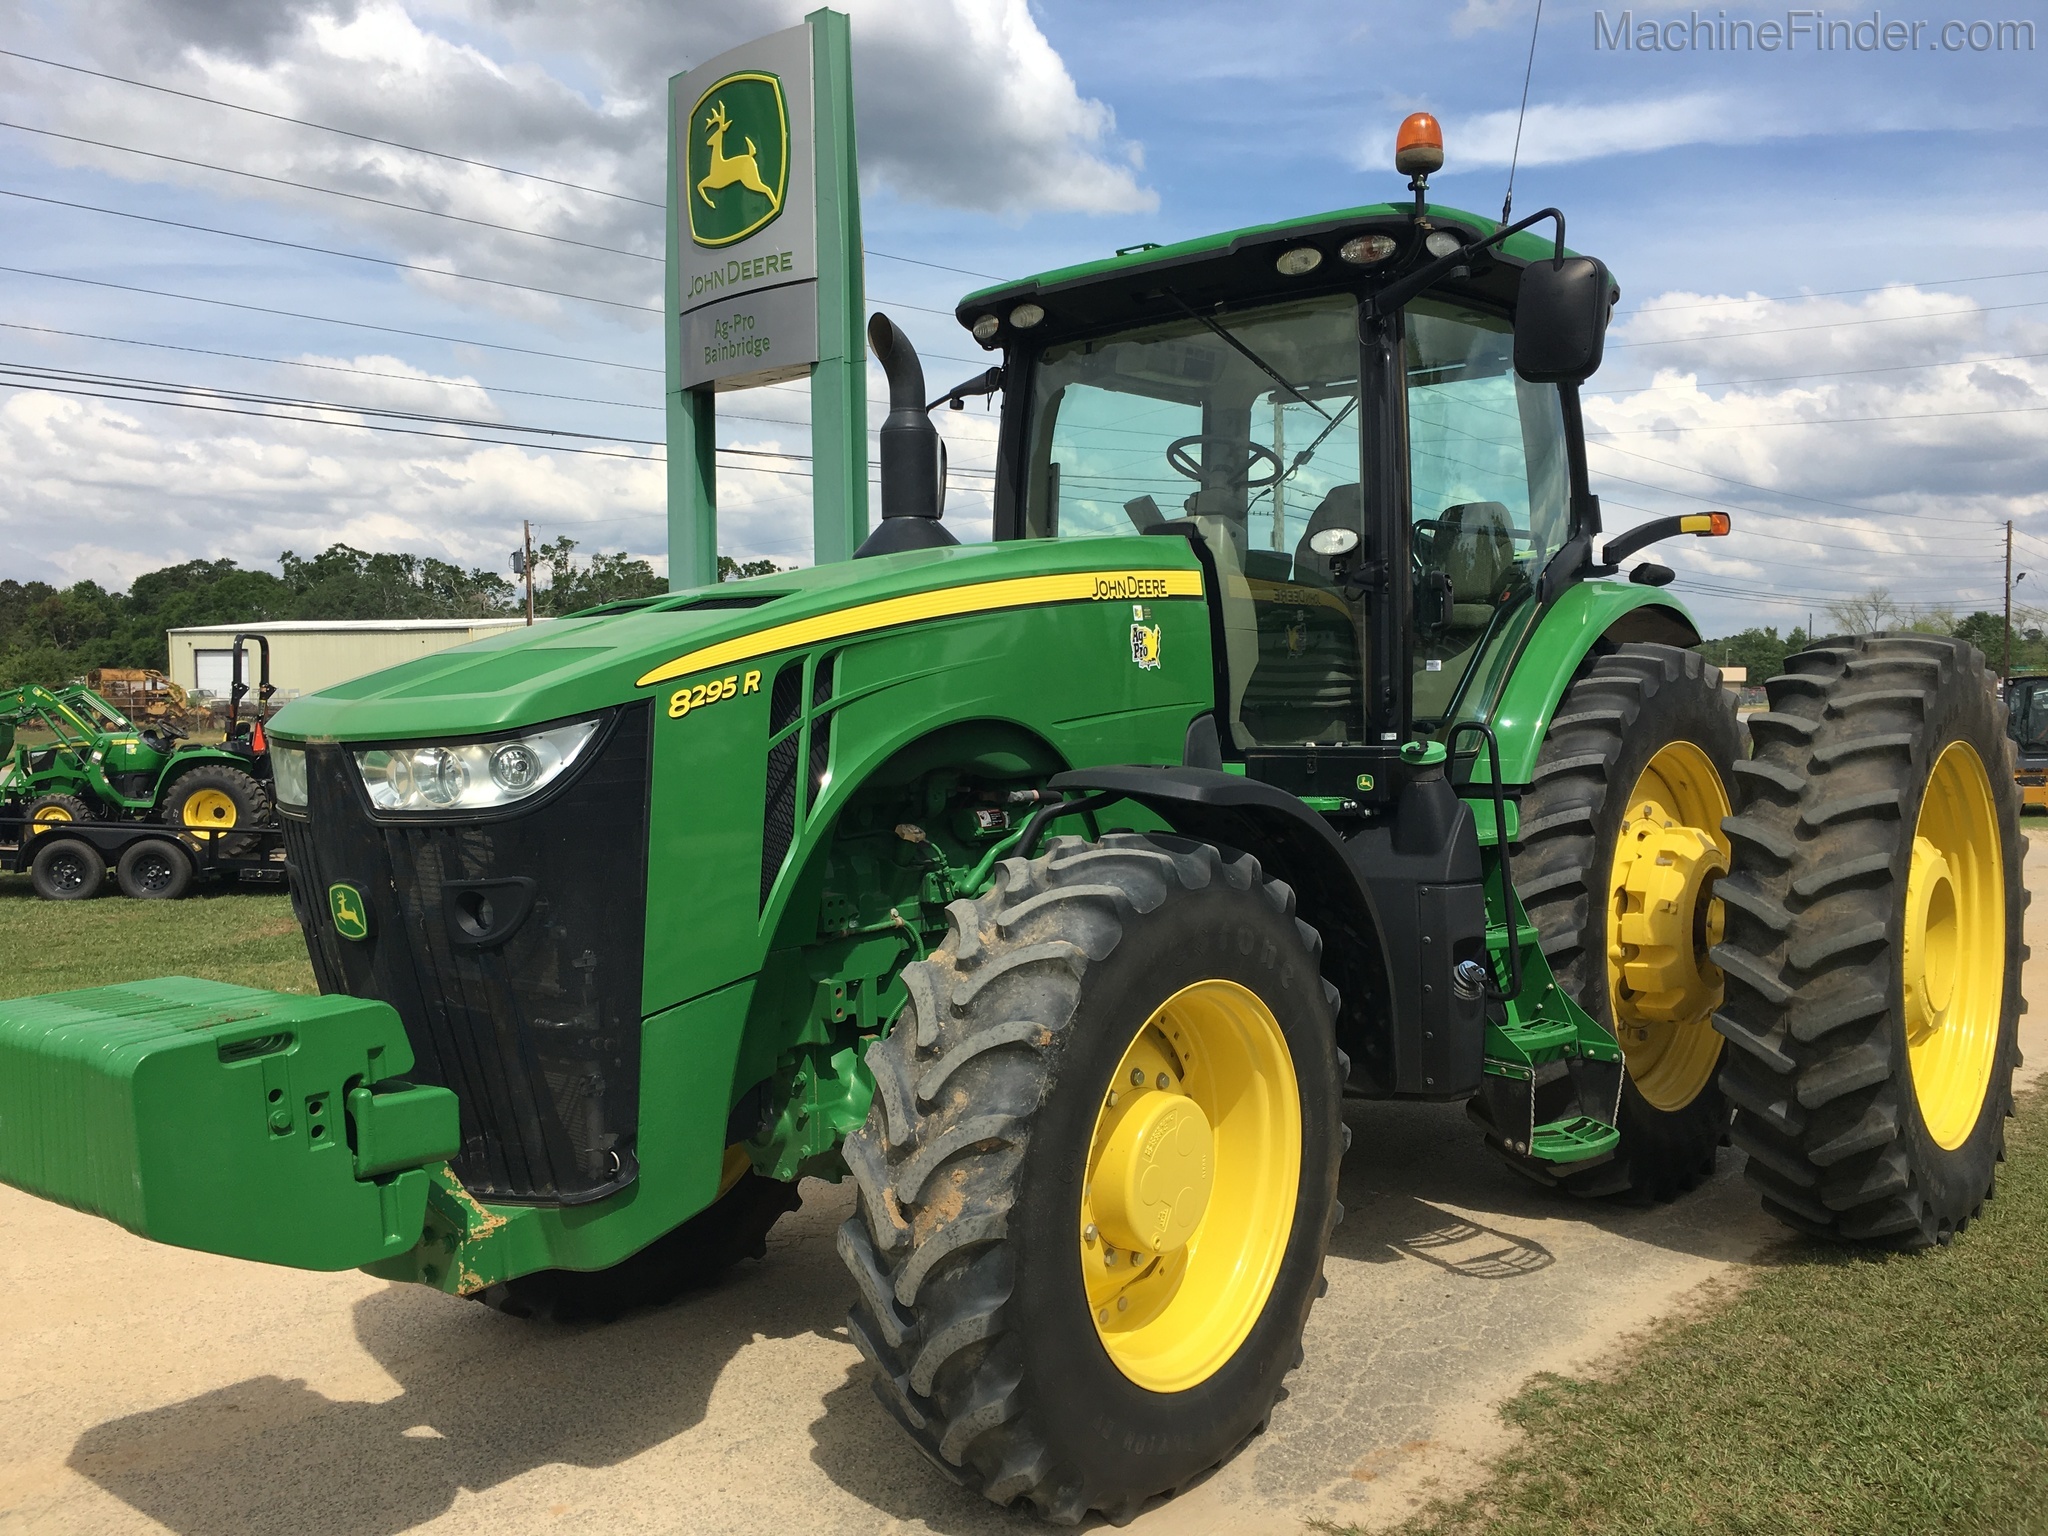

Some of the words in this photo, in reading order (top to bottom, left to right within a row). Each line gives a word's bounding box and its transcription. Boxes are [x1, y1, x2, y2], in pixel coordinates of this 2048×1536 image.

[688, 268, 725, 299] JOHN
[727, 252, 792, 285] DEERE
[714, 313, 755, 340] Ag-Pro
[704, 336, 770, 365] Bainbridge
[1092, 577, 1126, 597] JOHN
[1127, 576, 1167, 595] DEERE
[668, 675, 738, 718] 8295
[743, 670, 761, 695] R
